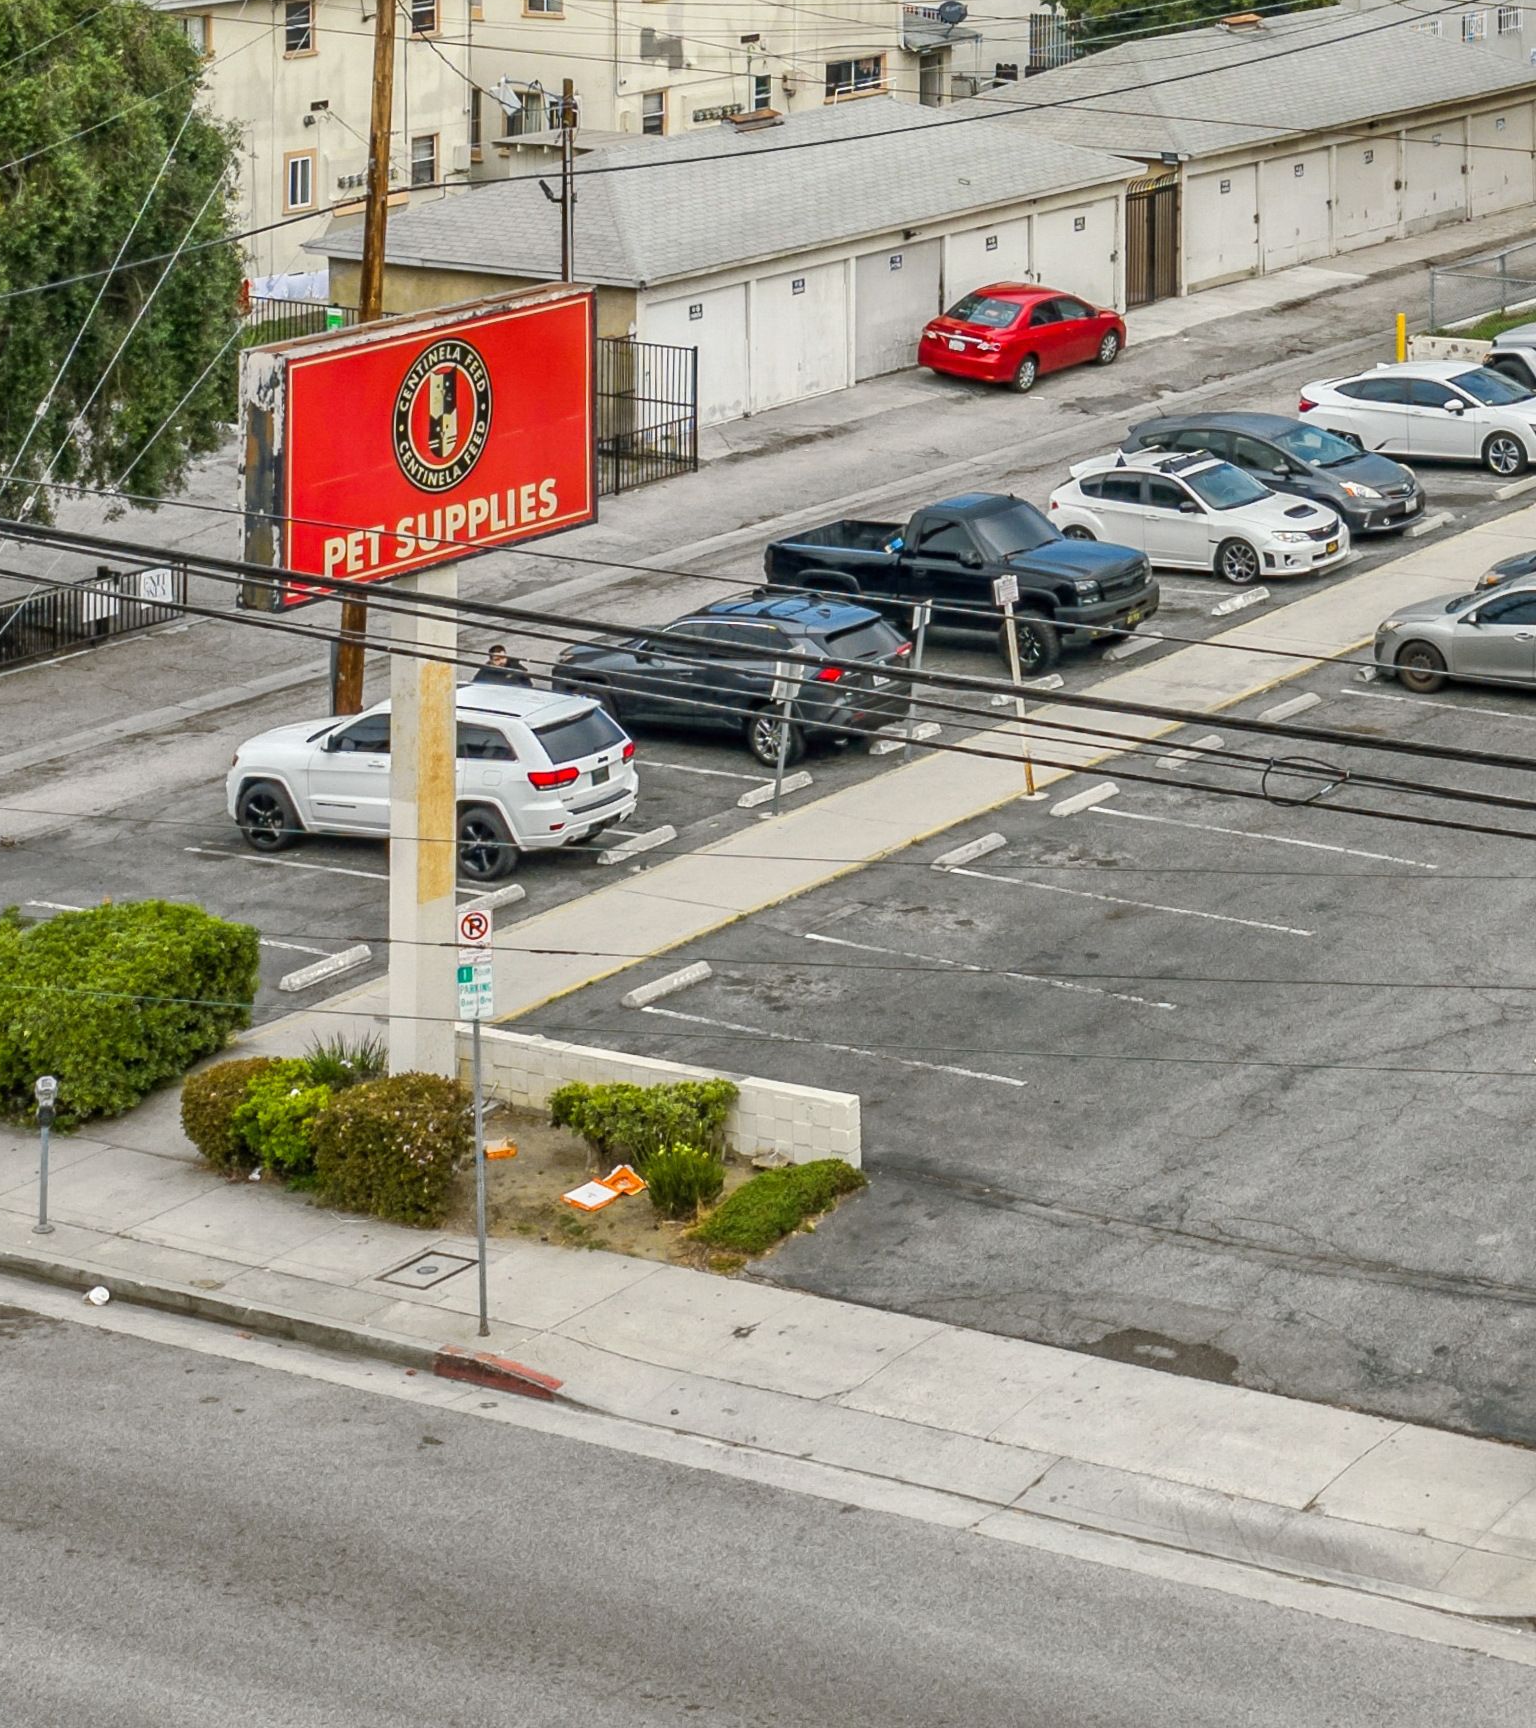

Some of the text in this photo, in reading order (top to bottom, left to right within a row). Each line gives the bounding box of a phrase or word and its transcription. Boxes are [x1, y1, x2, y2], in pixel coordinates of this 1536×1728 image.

[399, 345, 486, 412] CENTINELA FEED
[399, 420, 486, 487] CENTINELA FEED
[323, 478, 559, 578] PET SUPPLIES
[459, 982, 491, 994] PARKING
